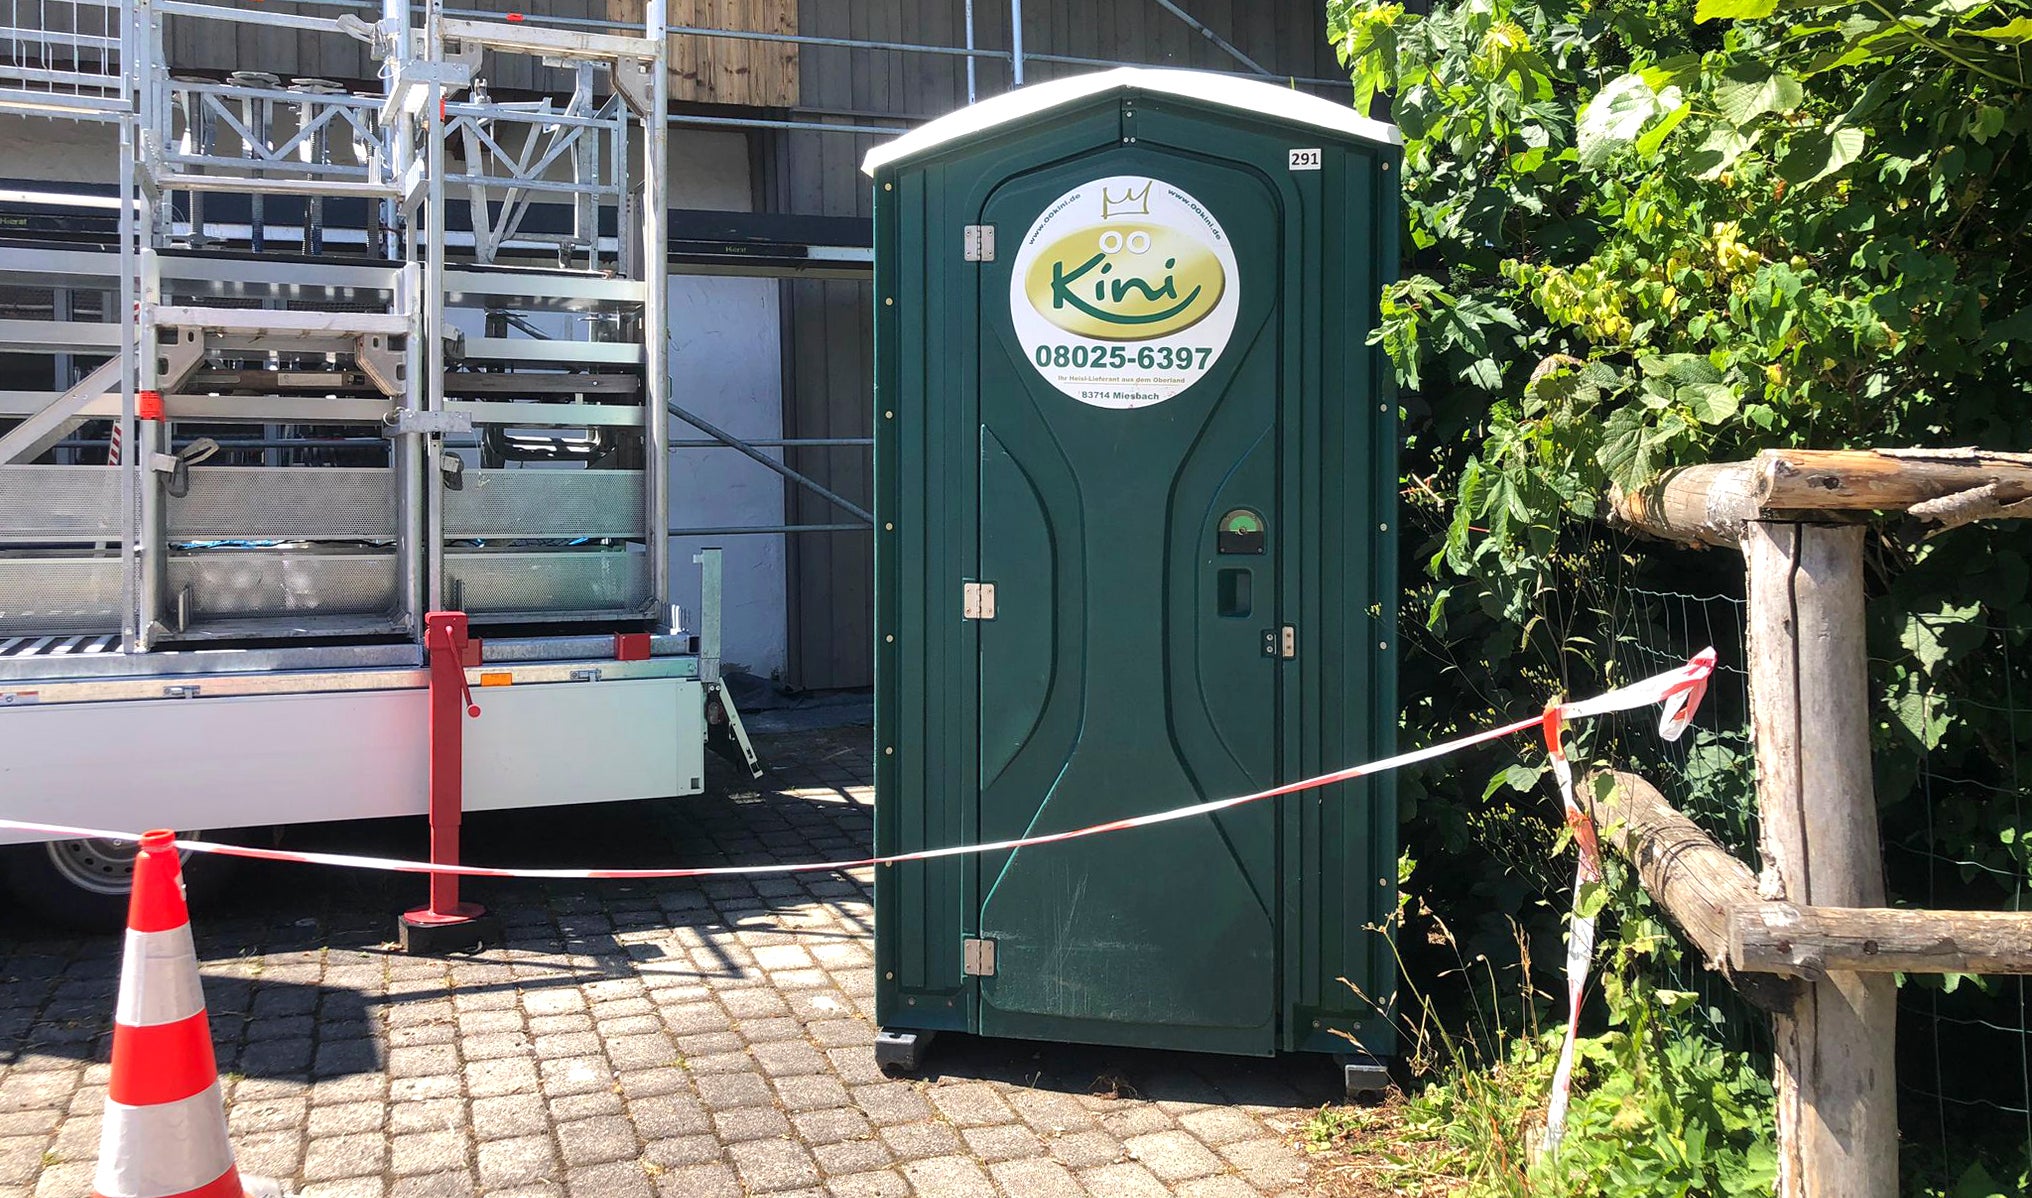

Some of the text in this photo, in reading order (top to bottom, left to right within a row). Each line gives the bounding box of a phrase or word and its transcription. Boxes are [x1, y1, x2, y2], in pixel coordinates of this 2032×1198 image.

[1291, 152, 1319, 166] 291
[1051, 253, 1201, 325] Kini
[1035, 345, 1213, 370] 08025-6397
[1069, 375, 1120, 383] Heisl-Lieferant
[1153, 376, 1186, 384] Oberland
[1081, 391, 1160, 400] 83714 Miesbach
